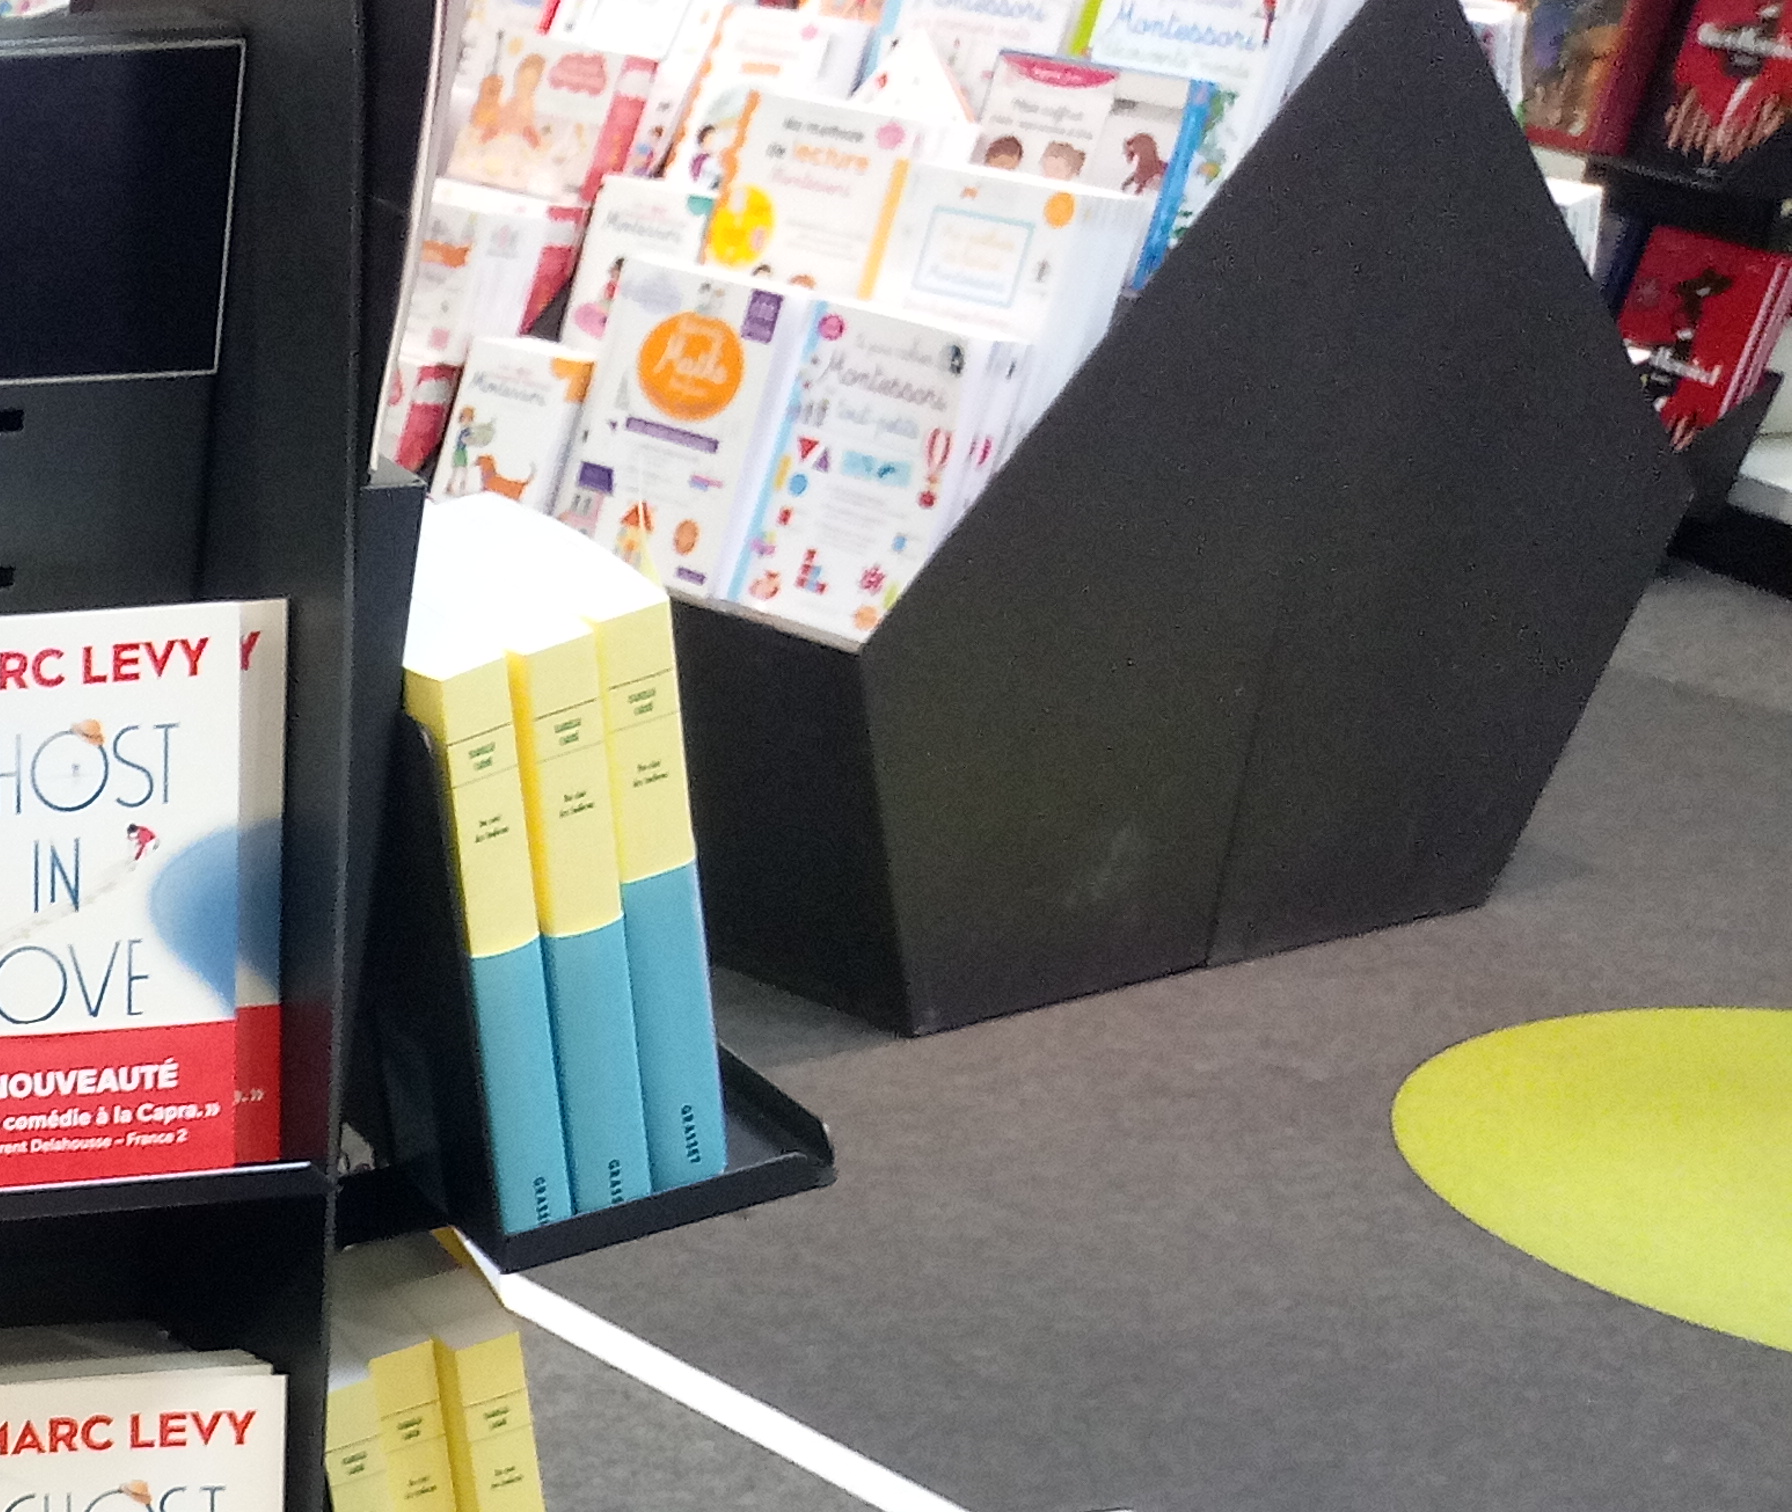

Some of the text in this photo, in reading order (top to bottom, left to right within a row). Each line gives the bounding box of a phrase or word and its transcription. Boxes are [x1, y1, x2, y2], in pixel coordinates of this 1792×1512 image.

[82, 637, 210, 684] LEVY
[32, 837, 81, 913] IN
[2, 1106, 92, 1133] comédie
[97, 1107, 111, 1127] à
[114, 1105, 133, 1126] la
[177, 1127, 188, 1143] 2
[129, 1409, 256, 1451] LEVY
